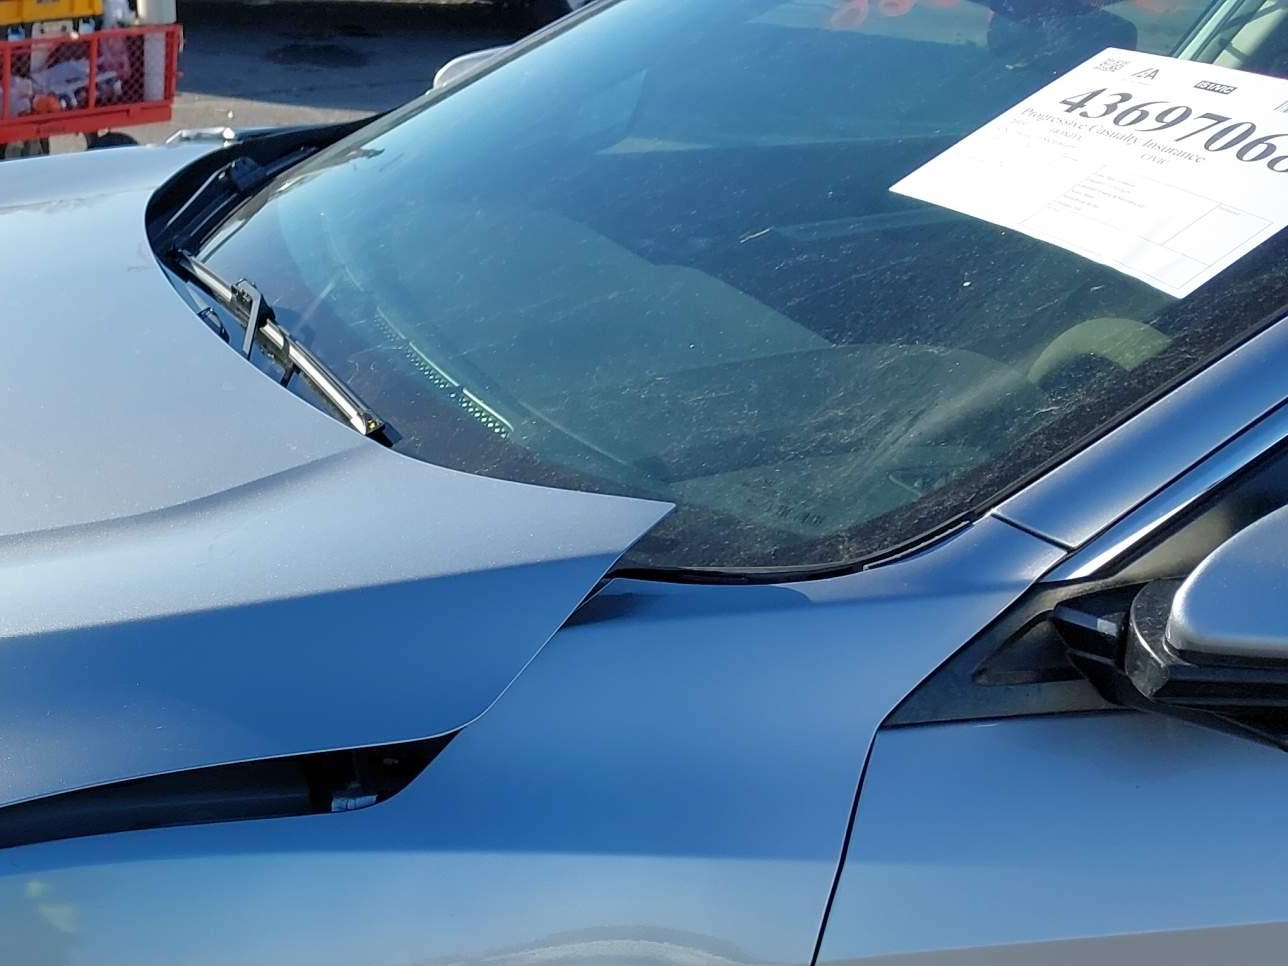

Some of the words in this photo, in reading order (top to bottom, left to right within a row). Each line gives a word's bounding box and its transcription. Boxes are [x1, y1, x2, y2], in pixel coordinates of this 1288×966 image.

[1021, 106, 1091, 131] Progressive
[1088, 122, 1143, 146] Casualty
[1141, 138, 1206, 165] Insurance
